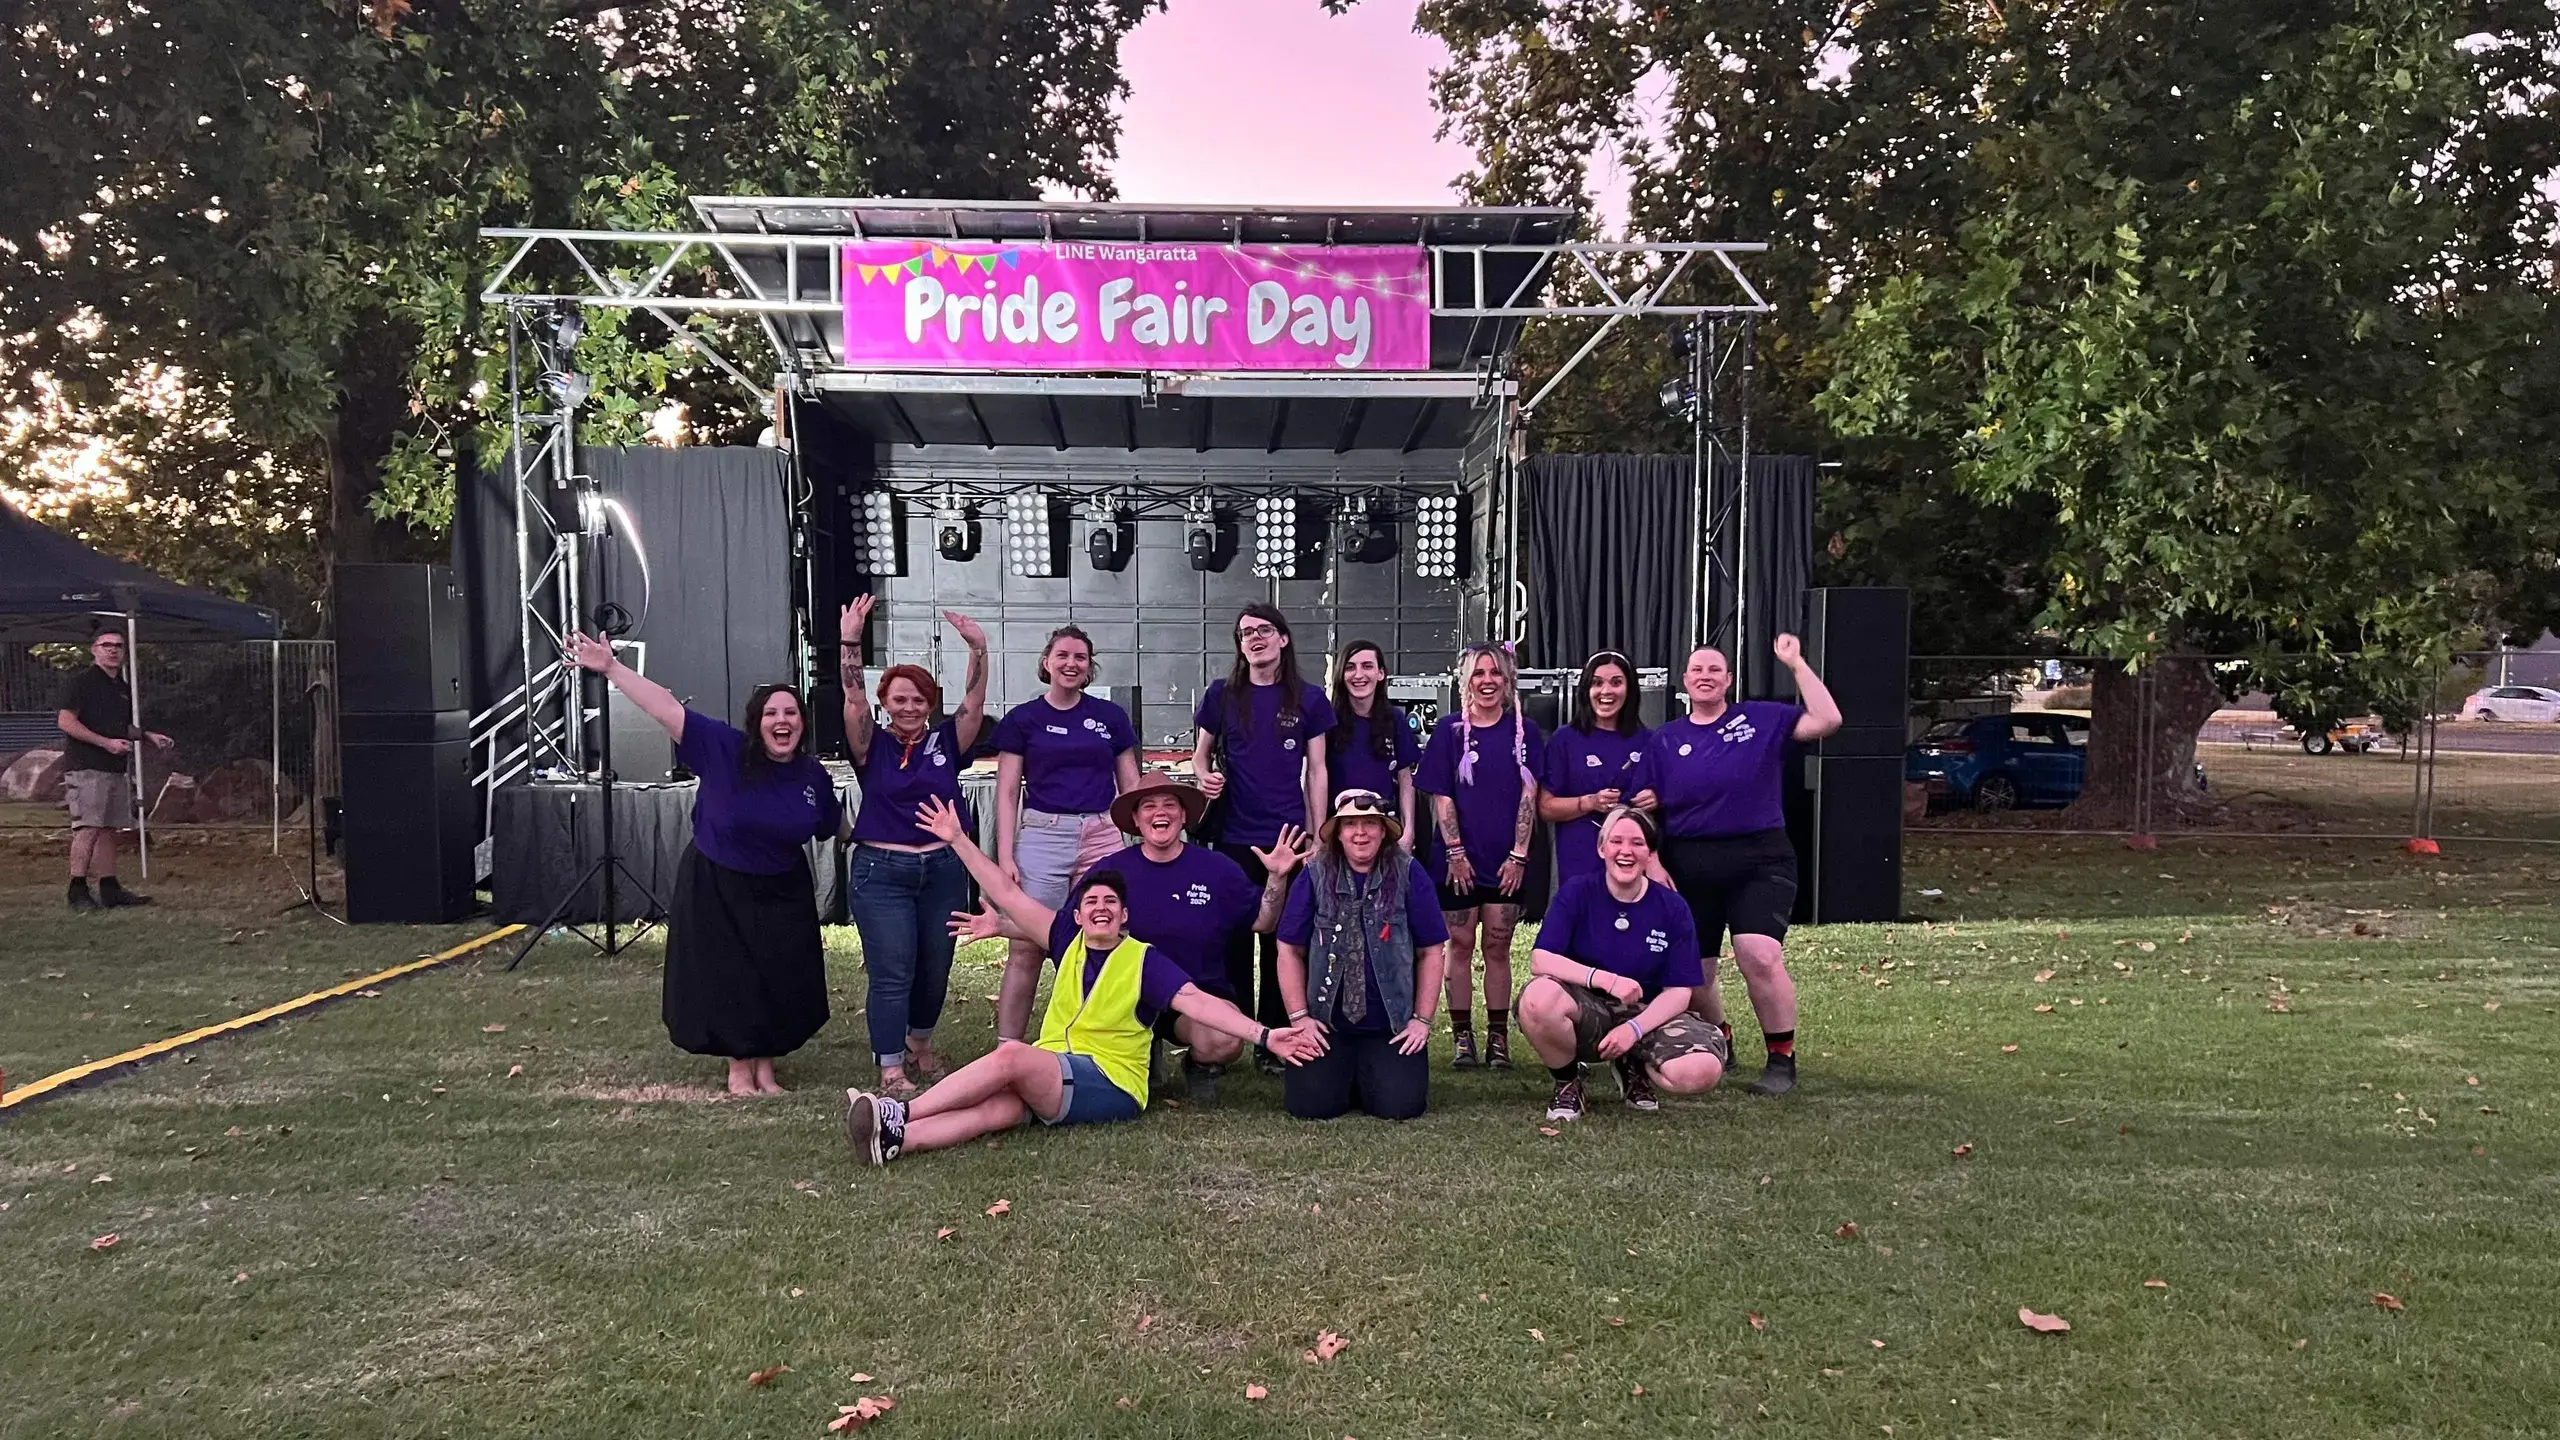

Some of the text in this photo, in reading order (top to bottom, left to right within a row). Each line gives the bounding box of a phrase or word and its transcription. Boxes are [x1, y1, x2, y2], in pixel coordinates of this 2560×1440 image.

[1055, 244, 1198, 264] LINE Wangaratta
[904, 276, 1371, 370] Pride Fair Day
